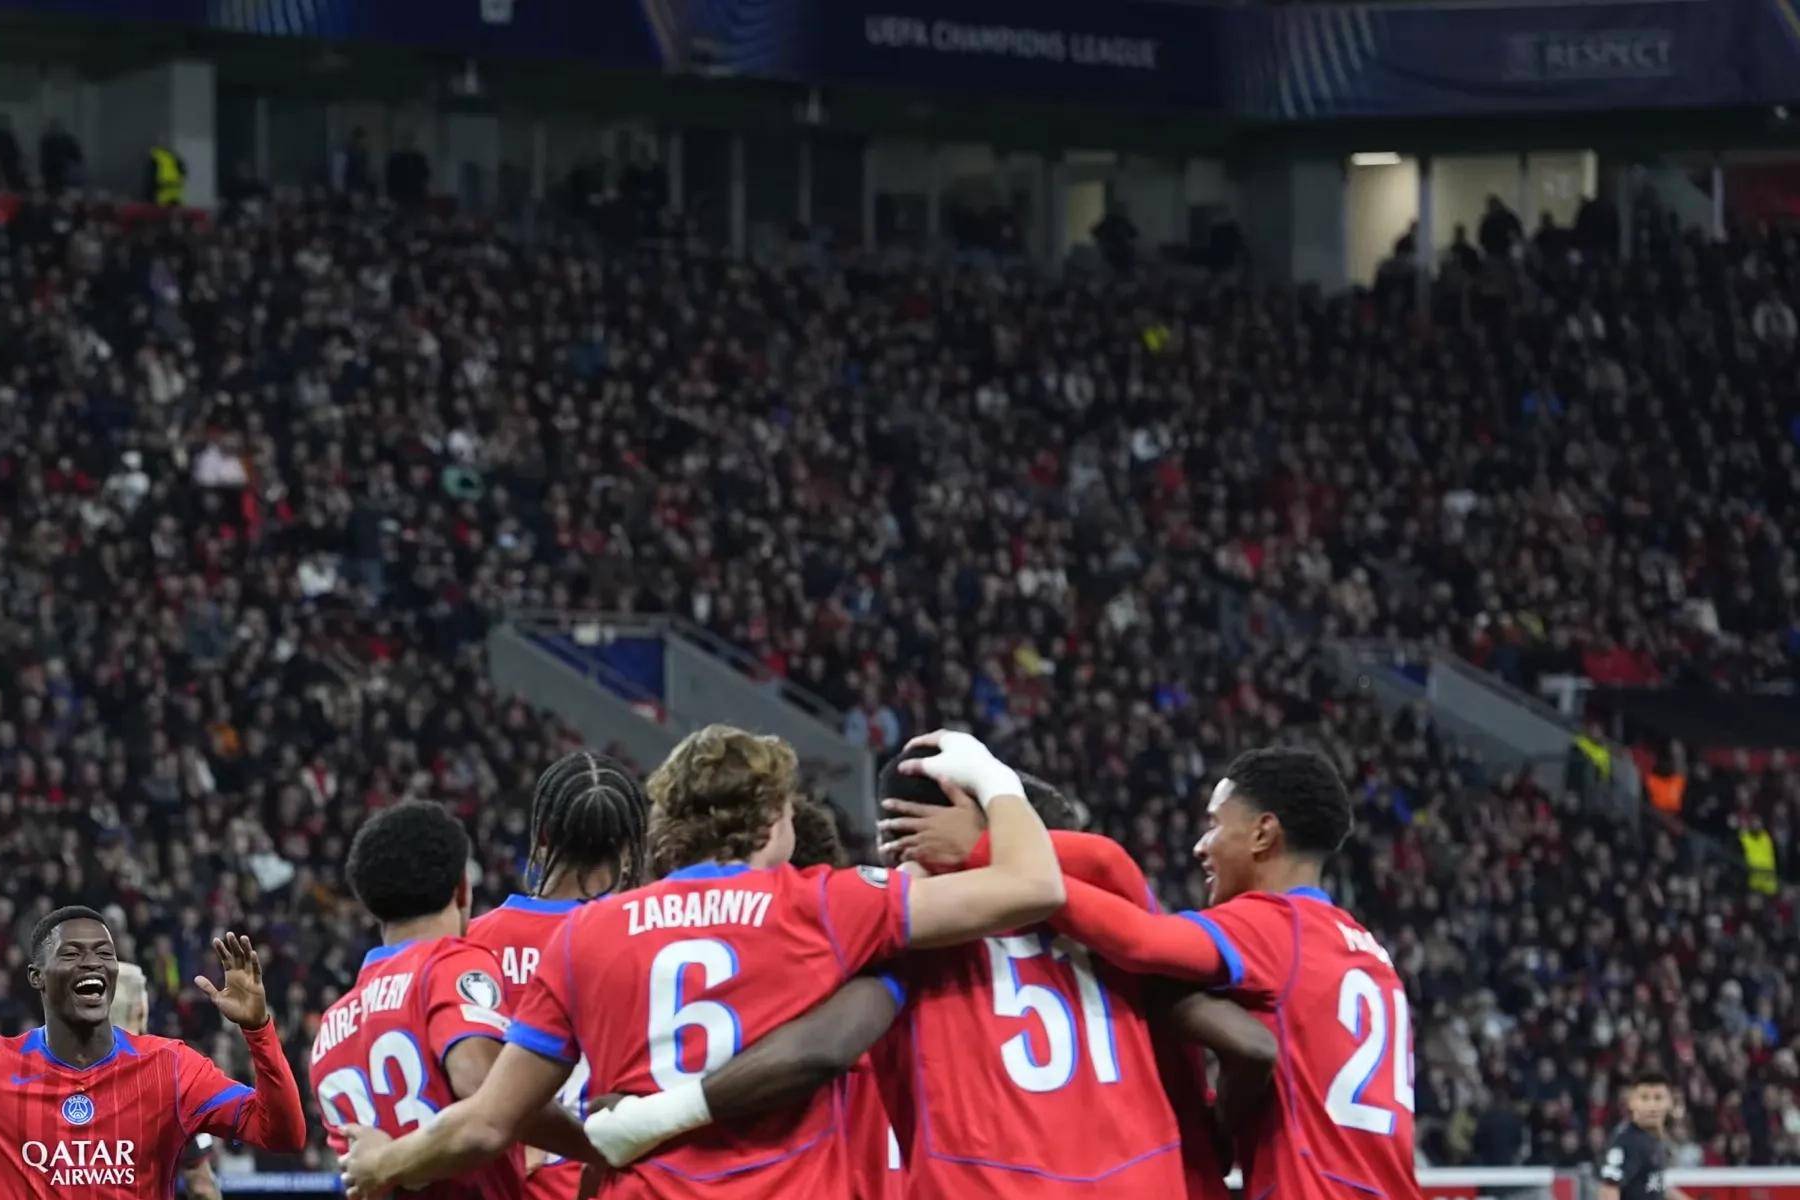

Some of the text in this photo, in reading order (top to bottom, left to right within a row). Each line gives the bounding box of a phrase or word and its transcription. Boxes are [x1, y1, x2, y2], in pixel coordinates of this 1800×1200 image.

[622, 888, 774, 936] ZABARNYI
[648, 937, 744, 1094] 6
[982, 931, 1123, 1093] 51
[22, 1139, 135, 1173] QATAR
[50, 1167, 135, 1186] AIRWAYS
